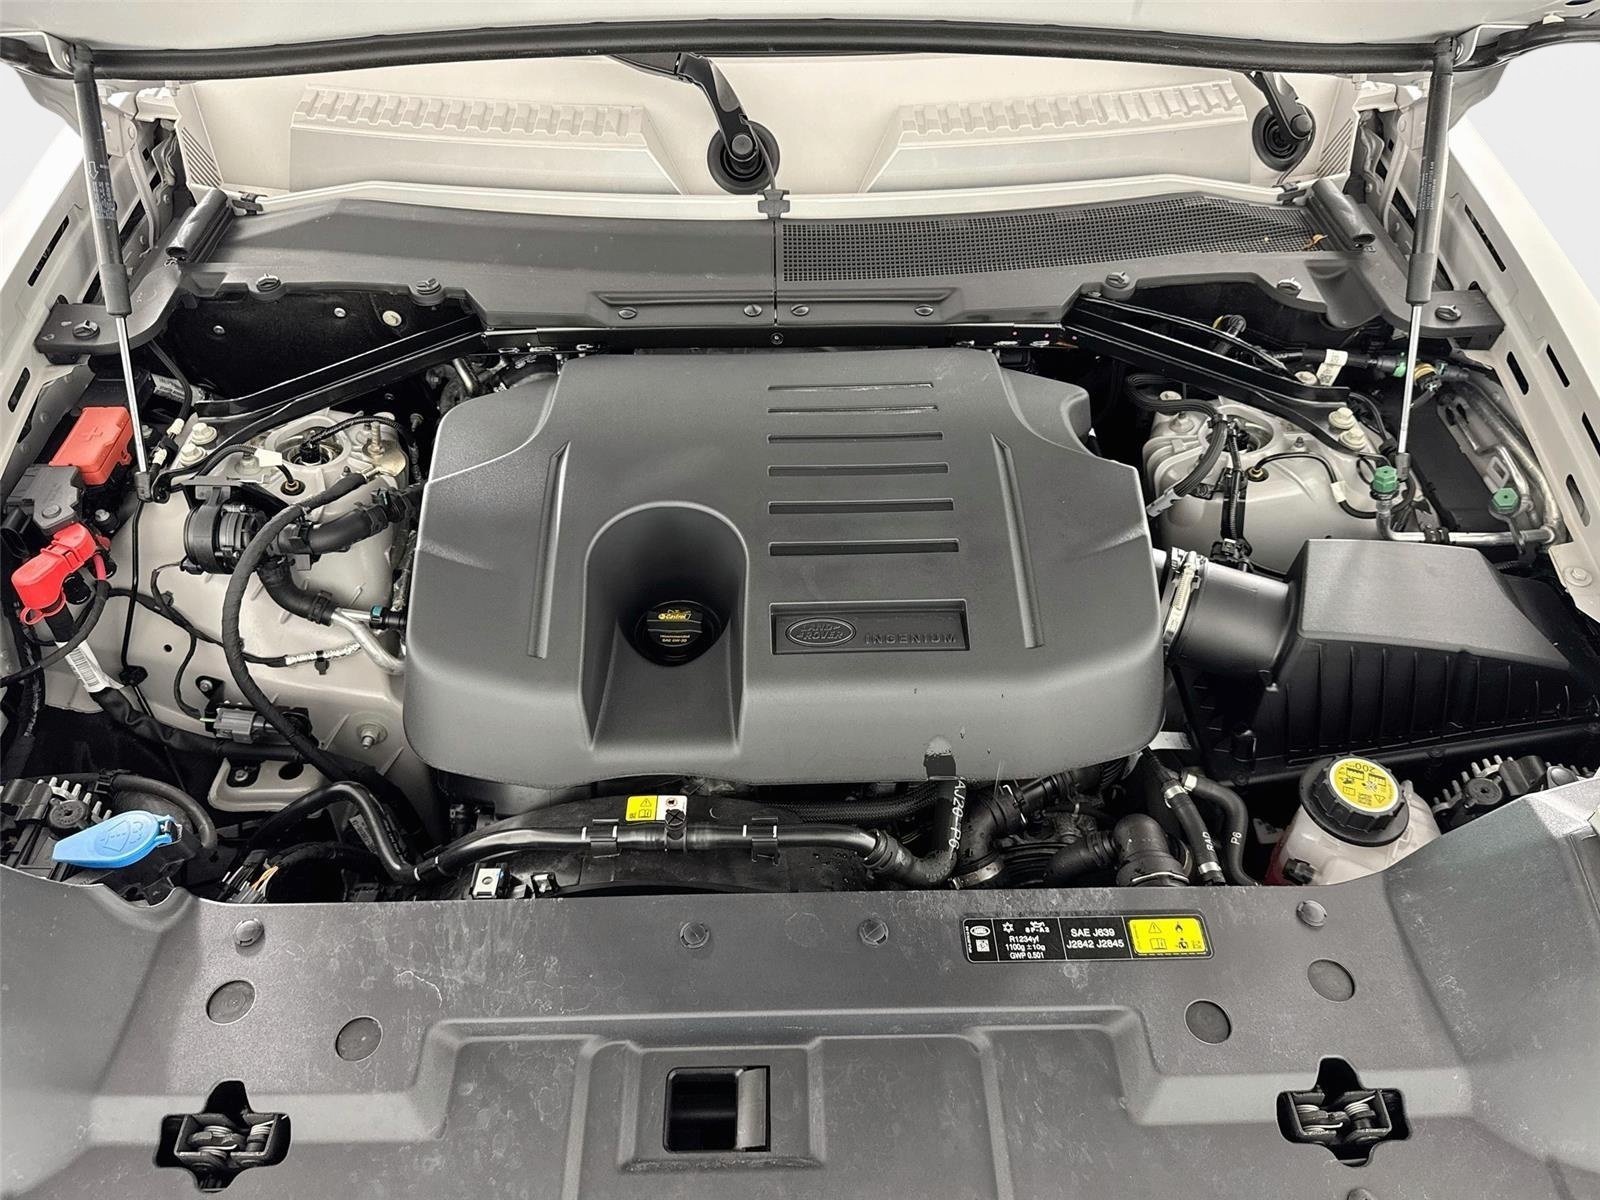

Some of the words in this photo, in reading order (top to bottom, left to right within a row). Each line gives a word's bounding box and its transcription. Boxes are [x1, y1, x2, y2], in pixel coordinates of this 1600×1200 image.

[803, 631, 843, 640] ROVER
[864, 632, 957, 645] INGENIUM
[1202, 831, 1215, 853] RAD
[1230, 831, 1242, 845] P6
[1070, 928, 1092, 938] SAE
[1092, 927, 1116, 937] J639
[1008, 934, 1040, 944] R1234yf
[1066, 939, 1095, 949] J2842
[1096, 938, 1125, 949] J2845
[1005, 943, 1026, 952] 1100g
[1009, 951, 1026, 960] GWP
[1027, 951, 1045, 960] 0.501
